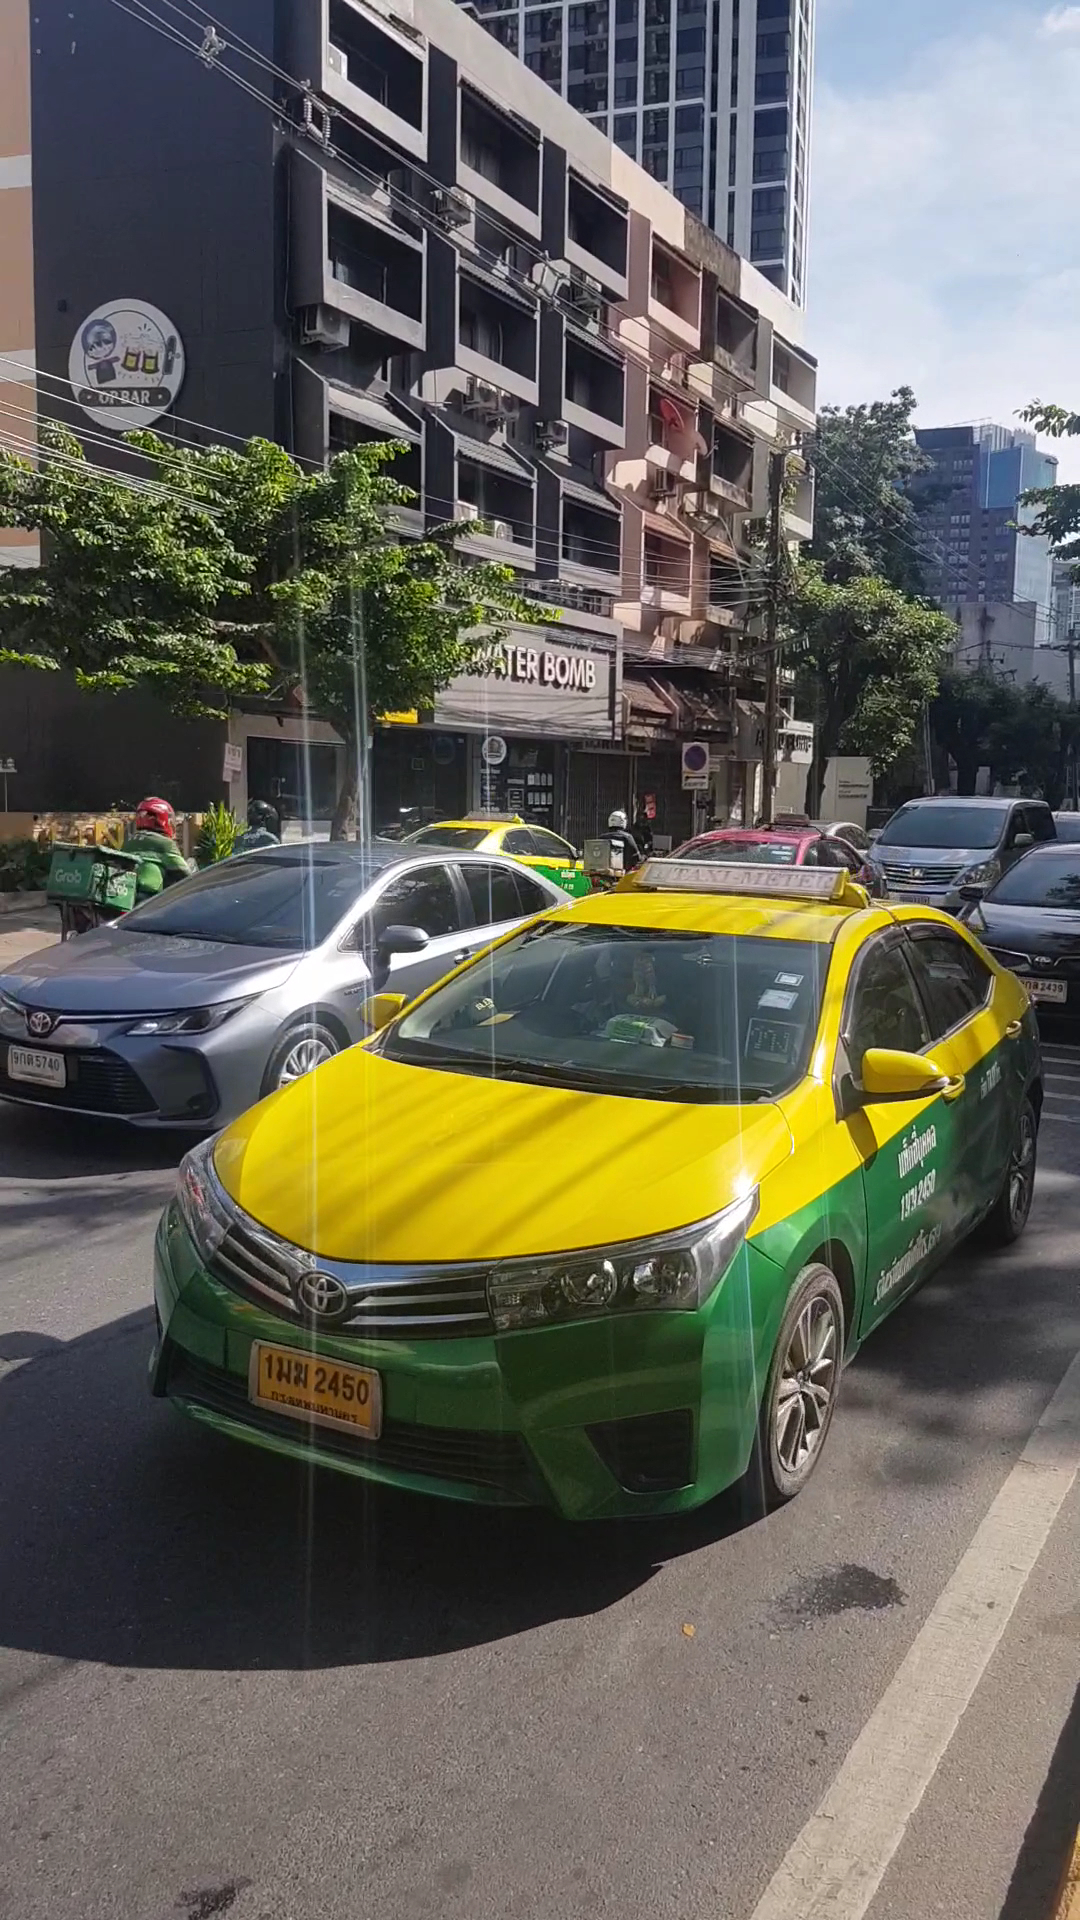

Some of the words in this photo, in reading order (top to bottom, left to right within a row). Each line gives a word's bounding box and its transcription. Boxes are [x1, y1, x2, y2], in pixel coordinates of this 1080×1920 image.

[120, 389, 150, 404] BAR
[543, 651, 596, 688] BOMB
[55, 868, 82, 883] Grab
[35, 1055, 60, 1072] 5740
[314, 1366, 370, 1406] 2450
